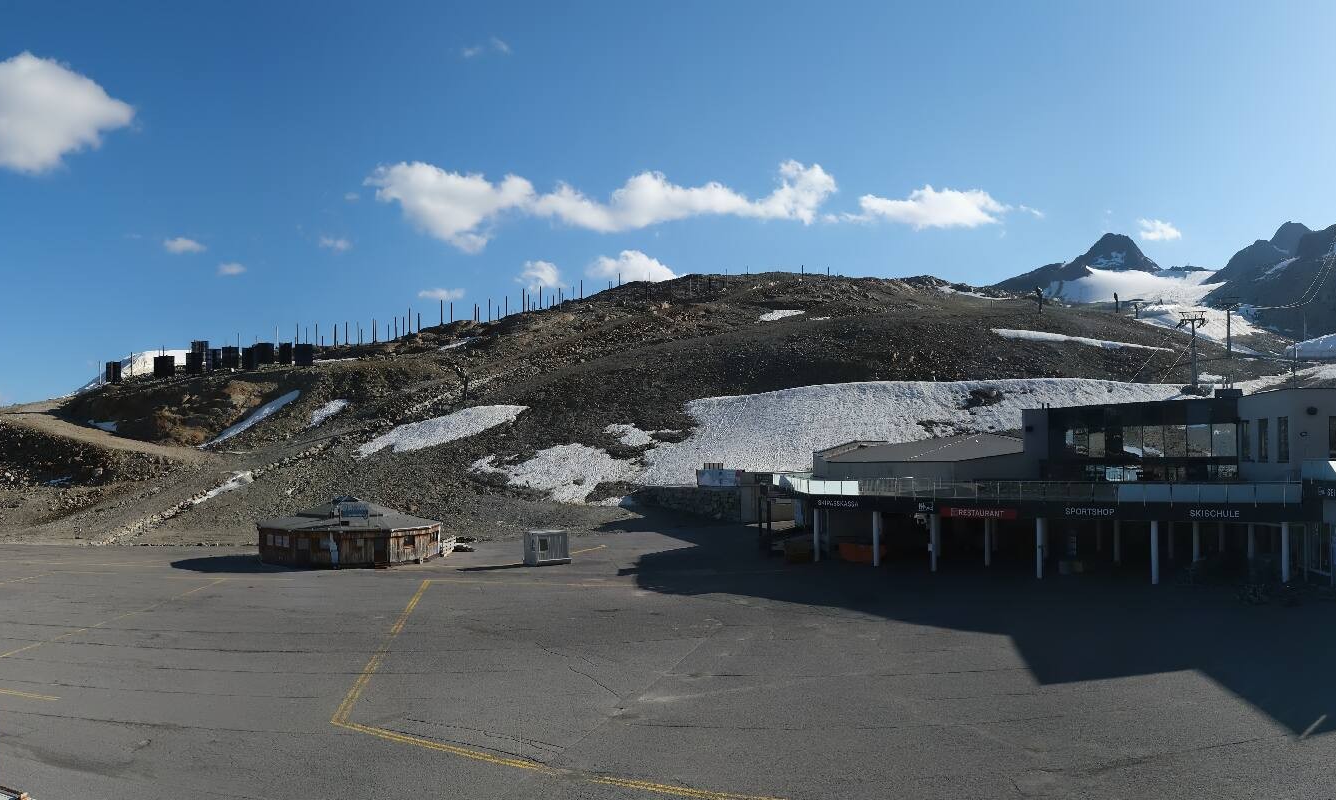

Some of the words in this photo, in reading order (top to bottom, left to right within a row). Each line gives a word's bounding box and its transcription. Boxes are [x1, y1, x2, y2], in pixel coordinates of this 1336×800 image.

[958, 508, 1004, 518] RESTAURANT
[1065, 507, 1114, 517] SPORTSHOP
[1189, 509, 1240, 518] SKISCHULE
